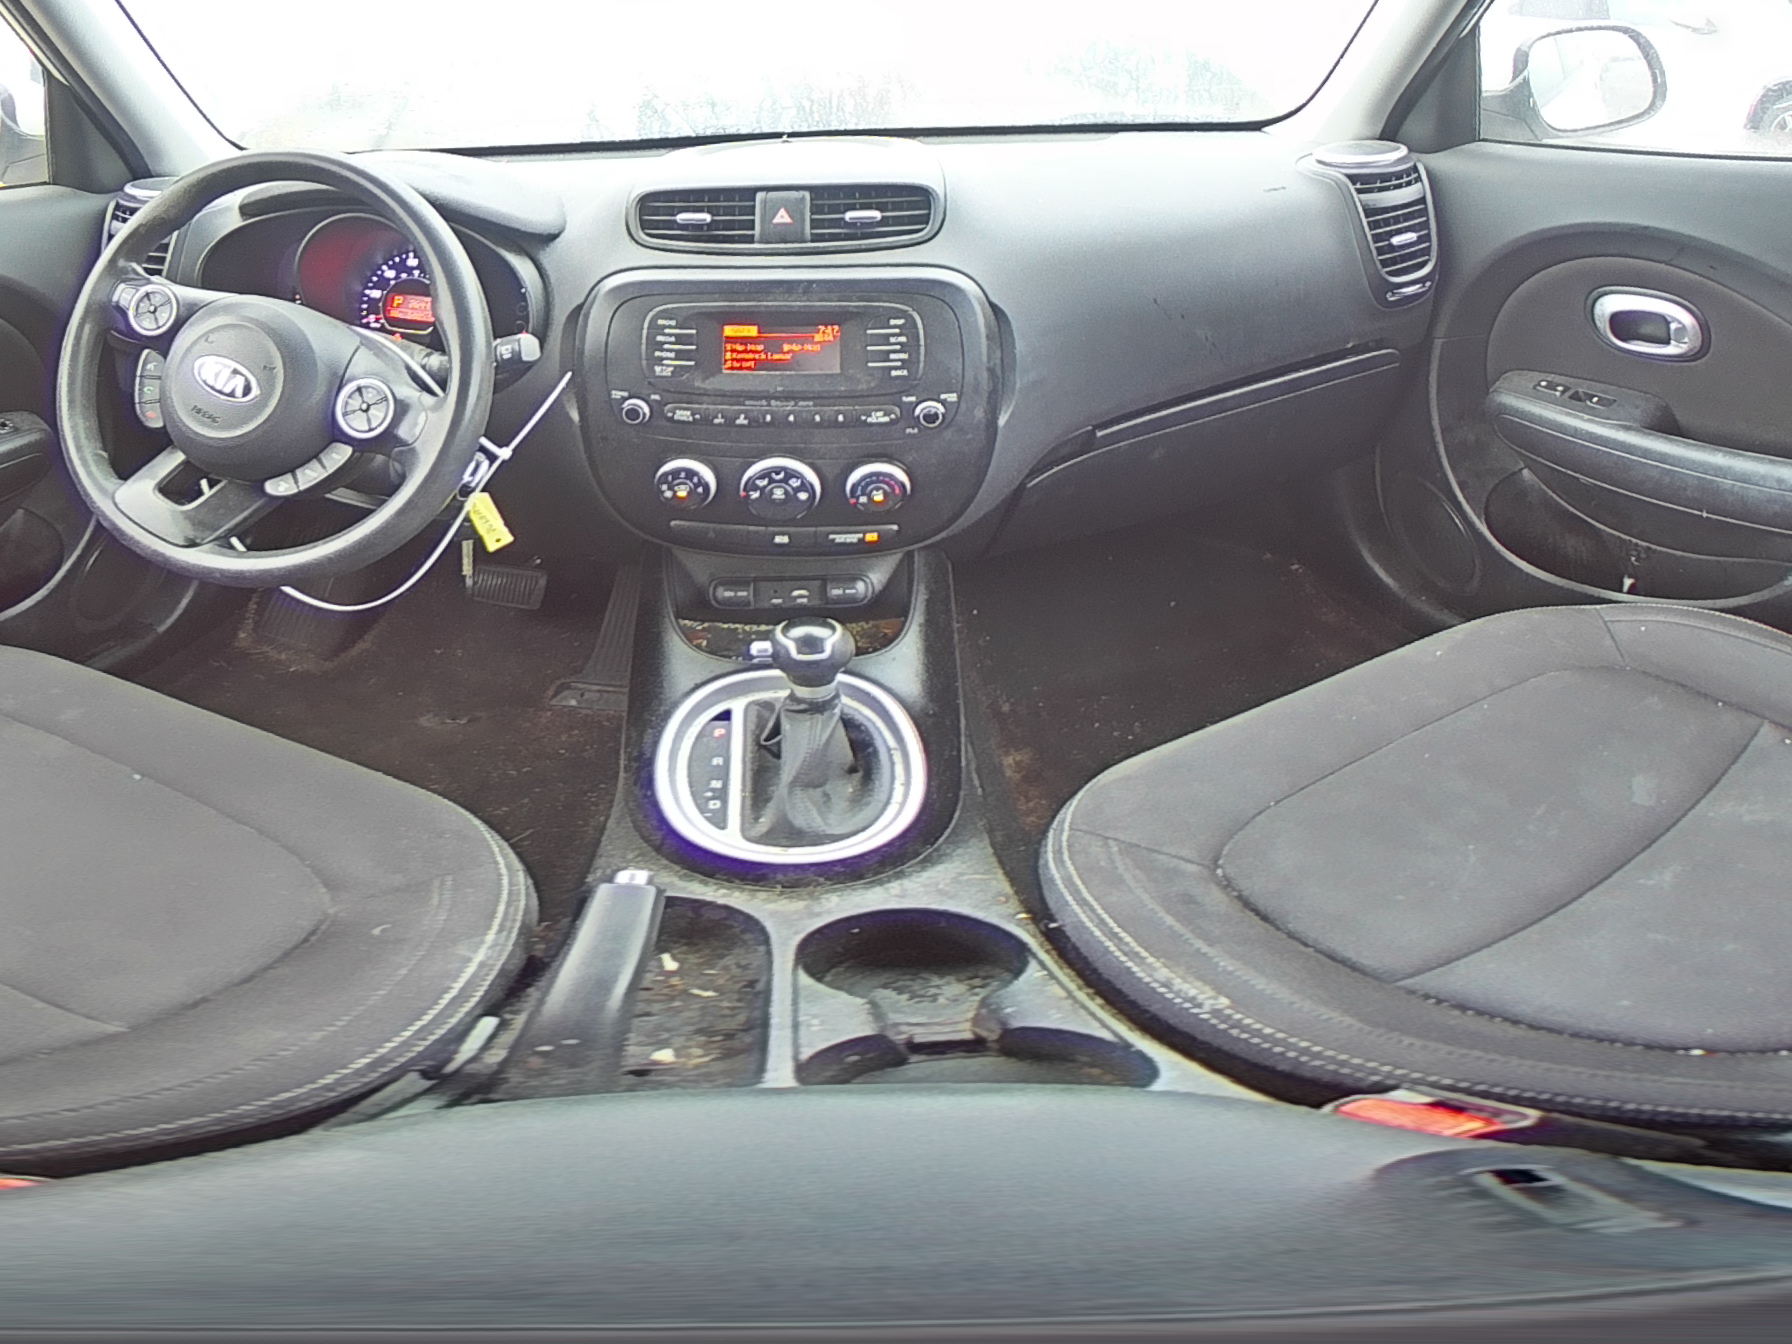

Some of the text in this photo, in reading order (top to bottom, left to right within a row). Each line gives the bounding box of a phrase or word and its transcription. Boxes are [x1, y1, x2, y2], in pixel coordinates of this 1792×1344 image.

[393, 295, 403, 307] P
[200, 360, 247, 399] KIA
[713, 728, 726, 738] P
[710, 779, 723, 789] N
[708, 800, 721, 810] D
